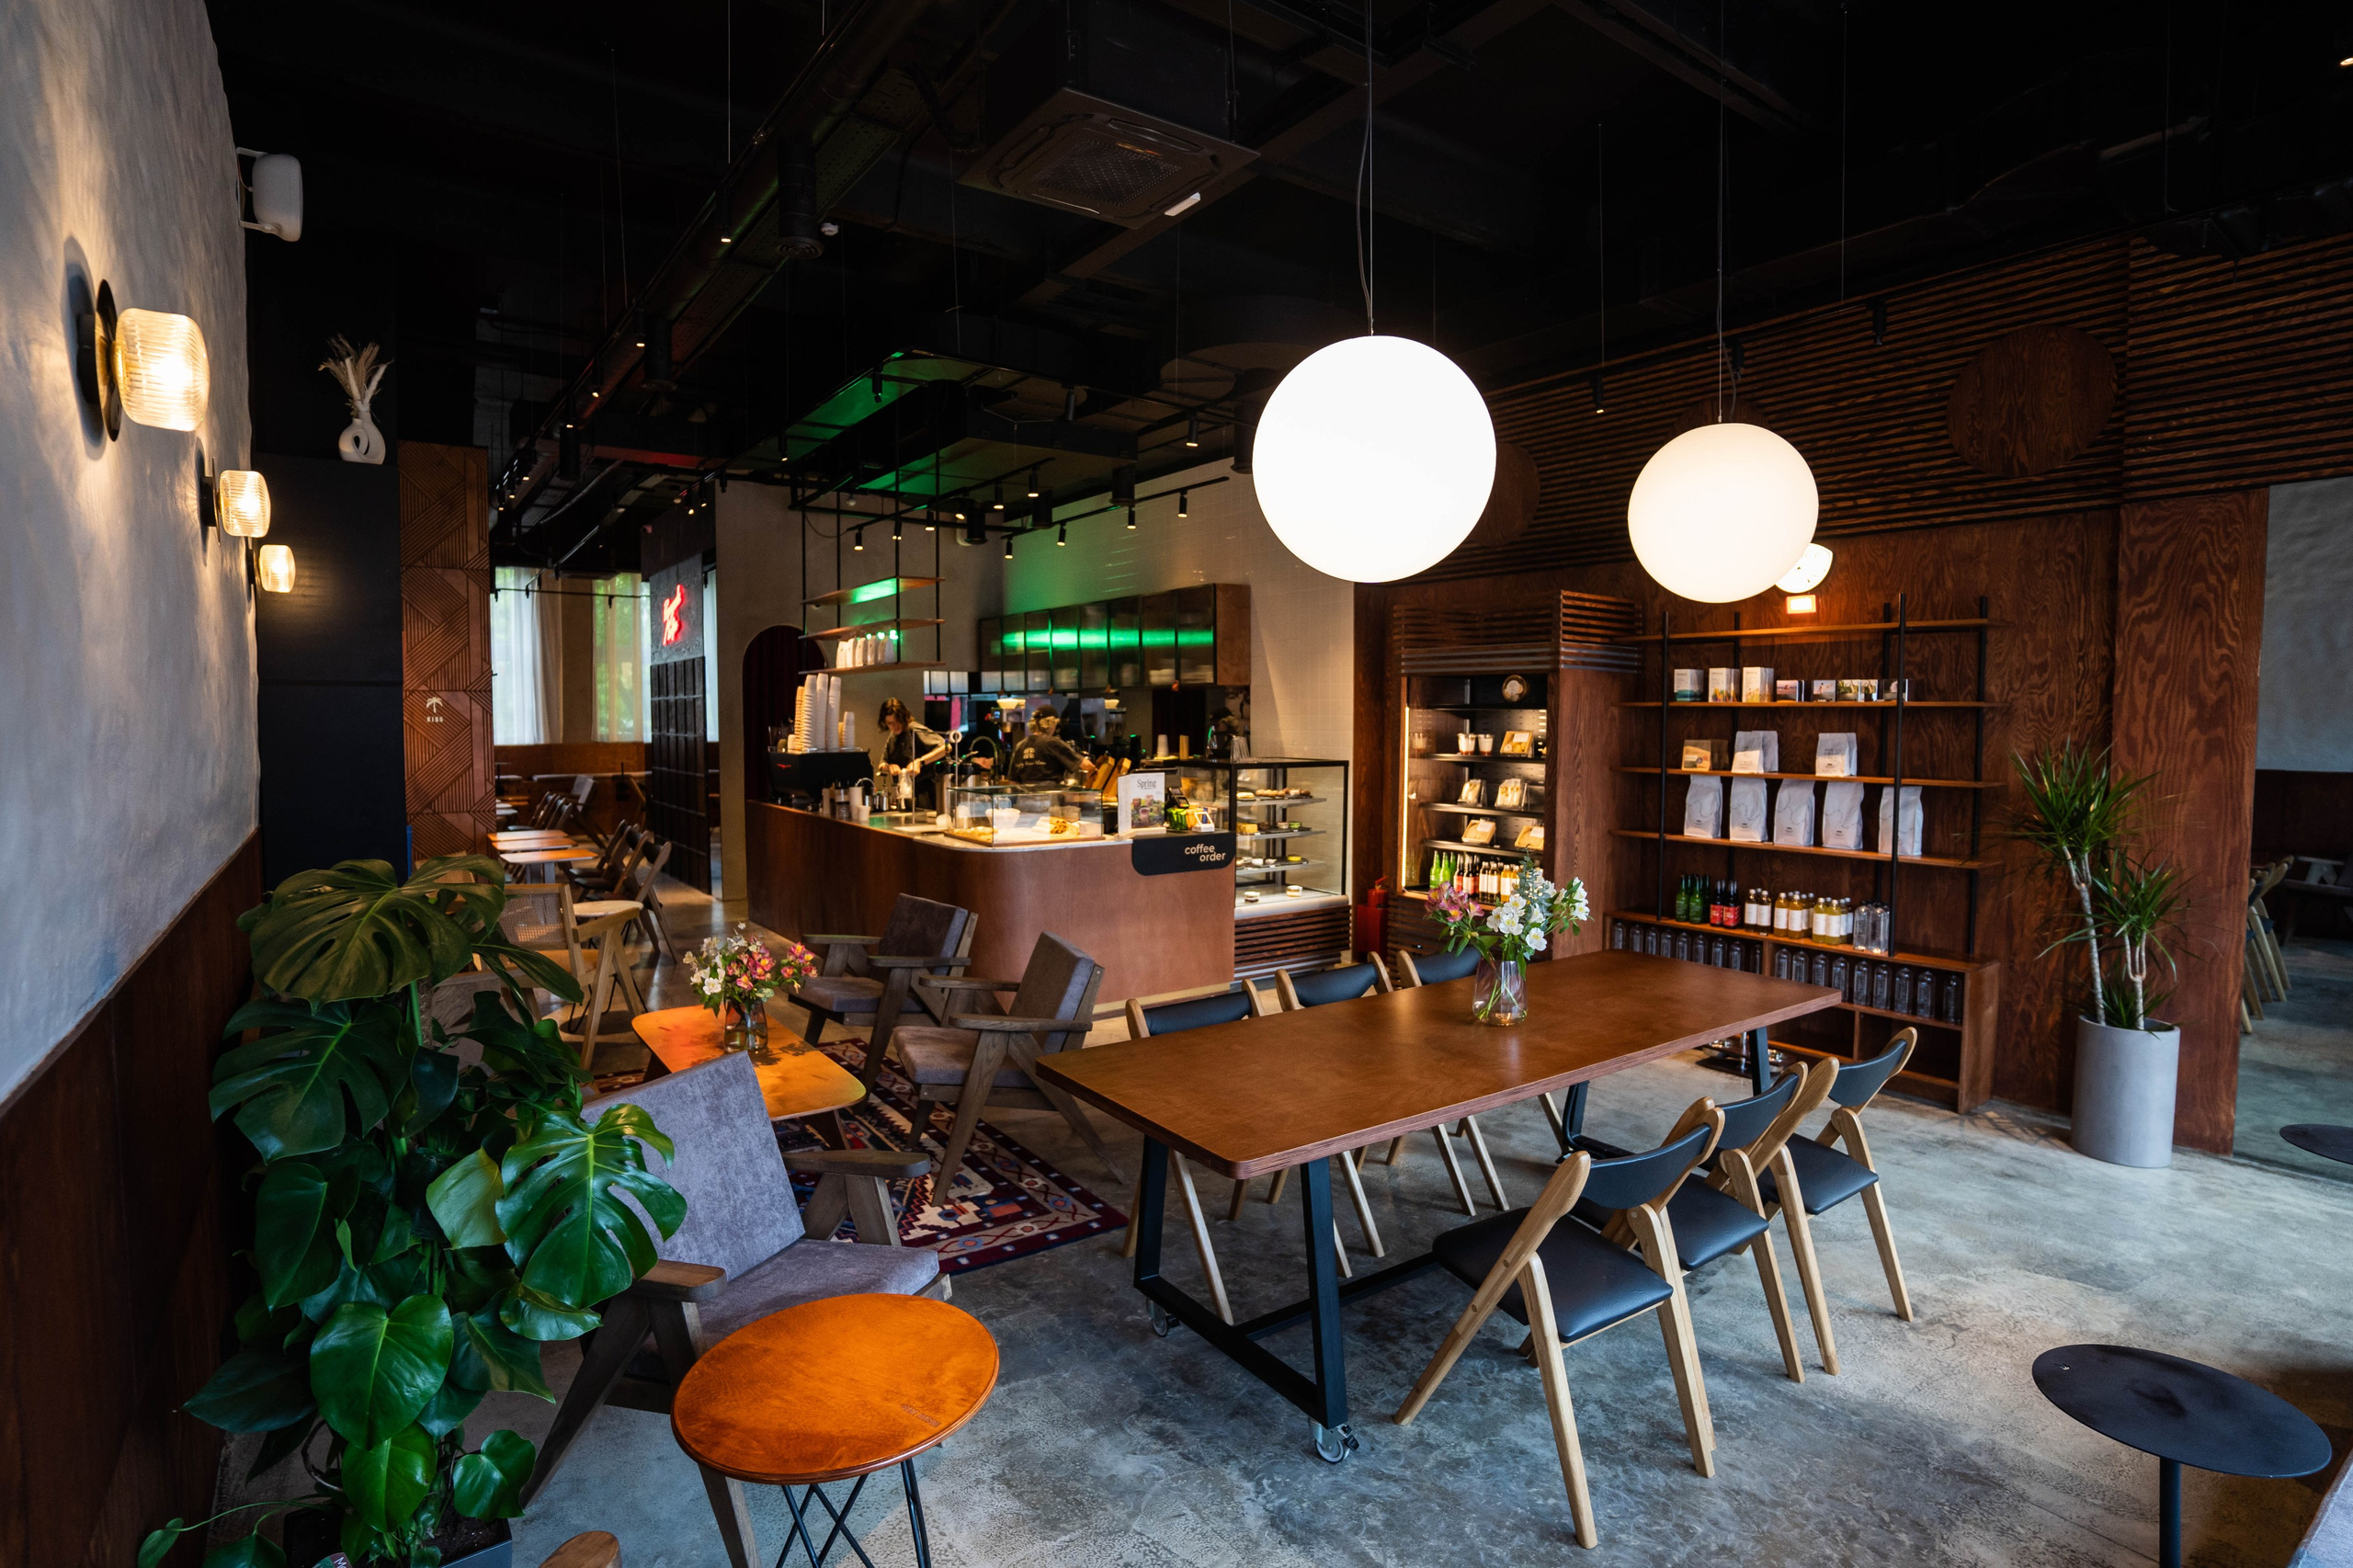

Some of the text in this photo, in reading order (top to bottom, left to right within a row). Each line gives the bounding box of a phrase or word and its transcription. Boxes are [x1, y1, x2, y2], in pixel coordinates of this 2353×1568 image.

[1137, 778, 1157, 790] Spring
[1184, 843, 1215, 855] coffee
[1199, 851, 1226, 862] order
